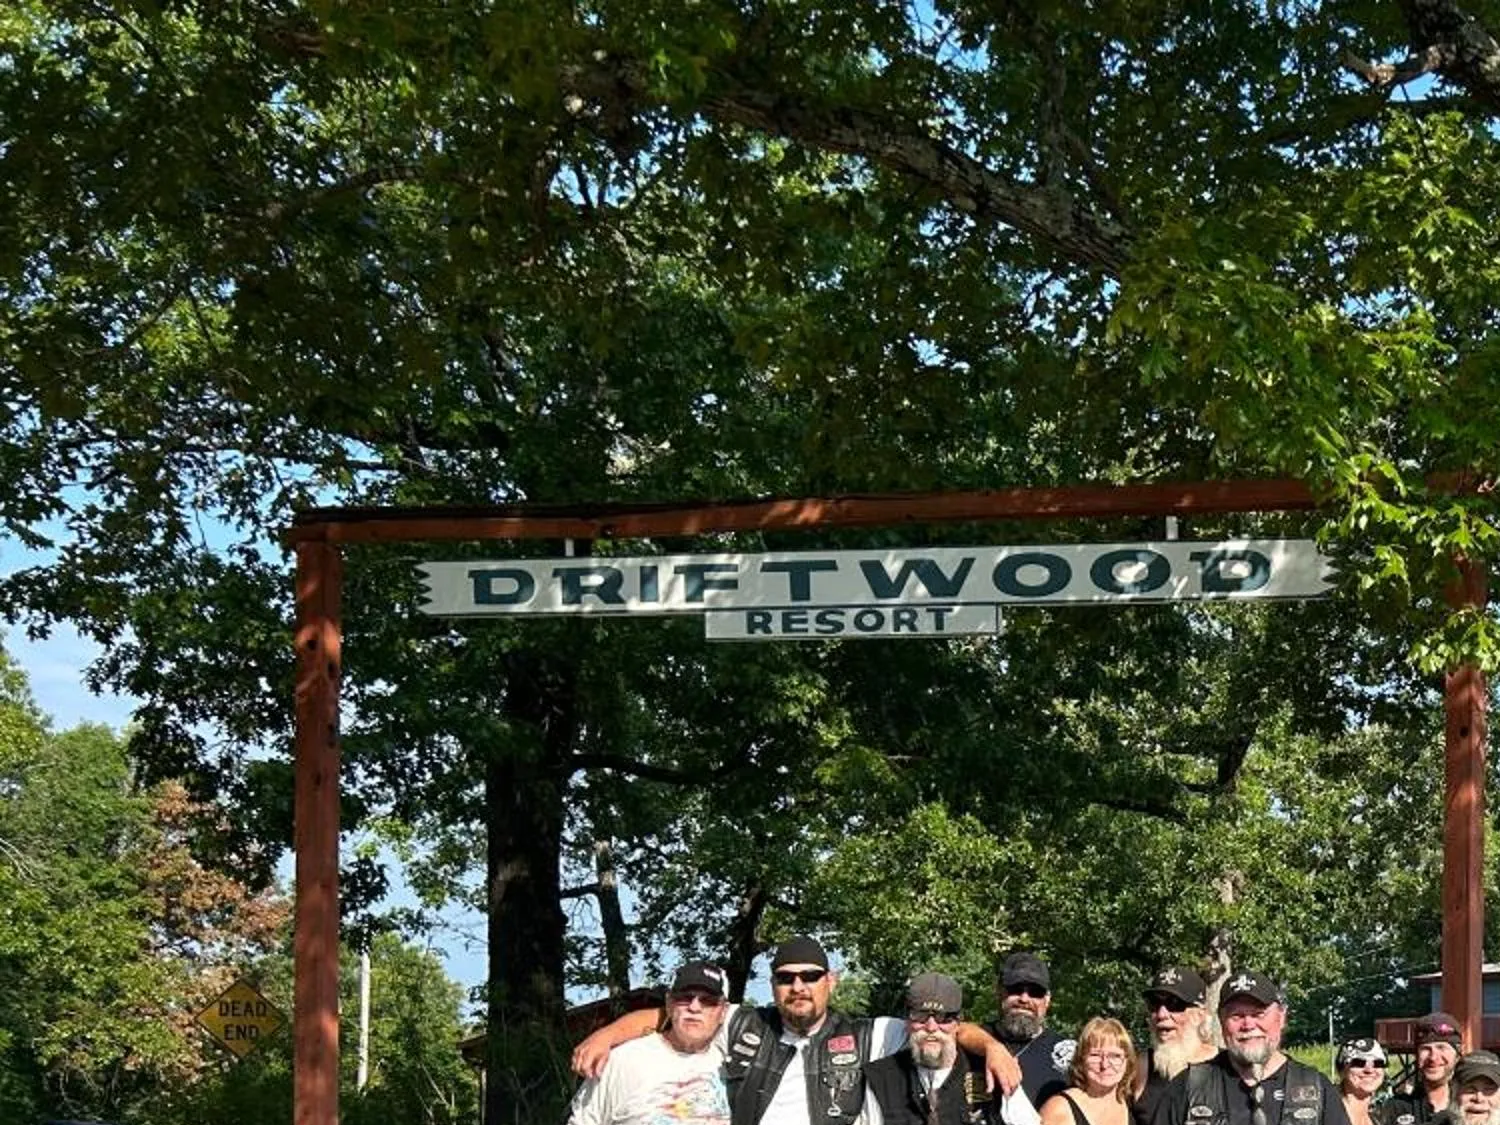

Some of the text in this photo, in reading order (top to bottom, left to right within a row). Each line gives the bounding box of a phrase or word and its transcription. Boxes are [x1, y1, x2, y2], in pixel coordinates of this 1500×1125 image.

[468, 548, 1272, 606] DRIFTWOOD
[745, 607, 953, 635] RESORT
[218, 1000, 267, 1017] DEAD
[224, 1024, 259, 1041] END
